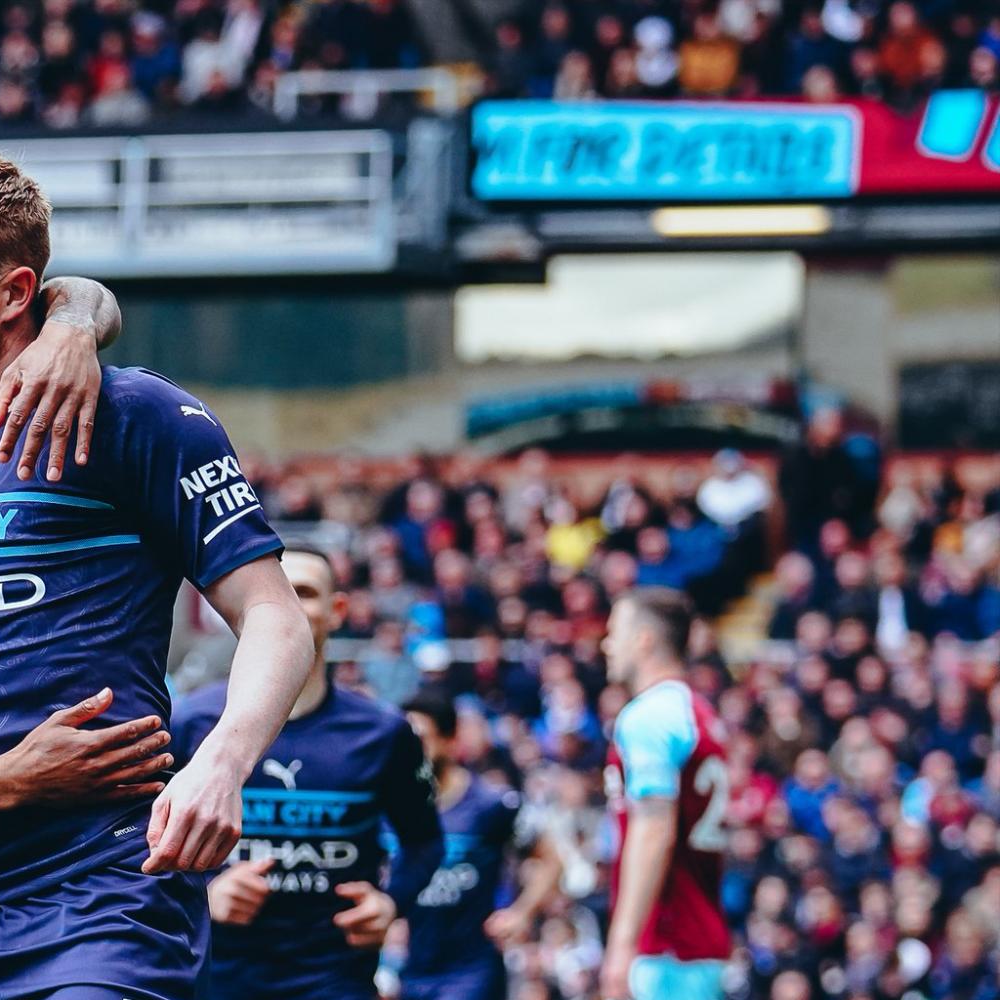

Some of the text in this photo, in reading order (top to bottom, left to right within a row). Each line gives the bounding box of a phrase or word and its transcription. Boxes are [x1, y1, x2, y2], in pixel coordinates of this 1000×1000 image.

[180, 455, 242, 500] NEX
[205, 481, 259, 517] TIR
[279, 803, 347, 825] CITY
